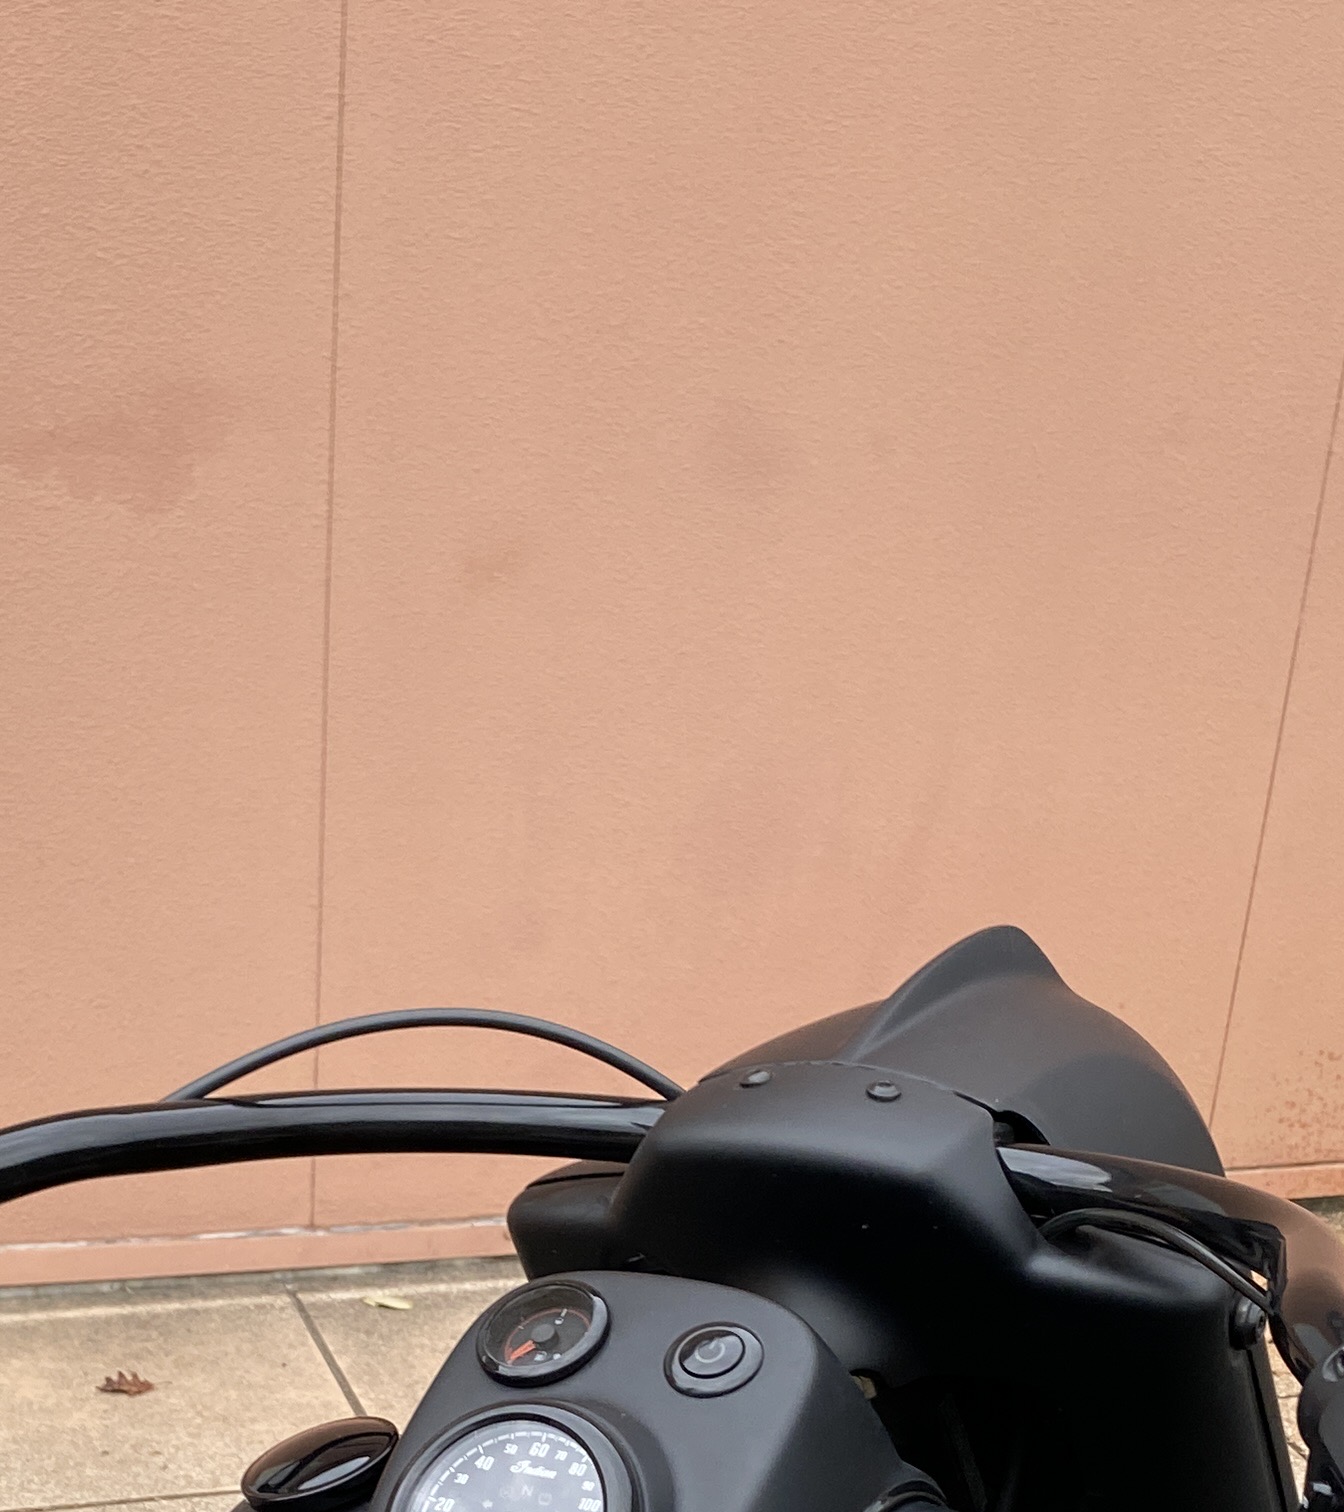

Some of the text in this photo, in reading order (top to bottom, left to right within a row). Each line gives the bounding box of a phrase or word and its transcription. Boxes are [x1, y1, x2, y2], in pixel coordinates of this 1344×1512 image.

[503, 1443, 519, 1456] 50
[528, 1442, 550, 1458] 60
[554, 1449, 569, 1461] 70
[474, 1455, 495, 1471] 40
[509, 1459, 558, 1480] Indian
[568, 1462, 588, 1477] 80
[434, 1496, 456, 1512] 20
[577, 1497, 601, 1512] 100
